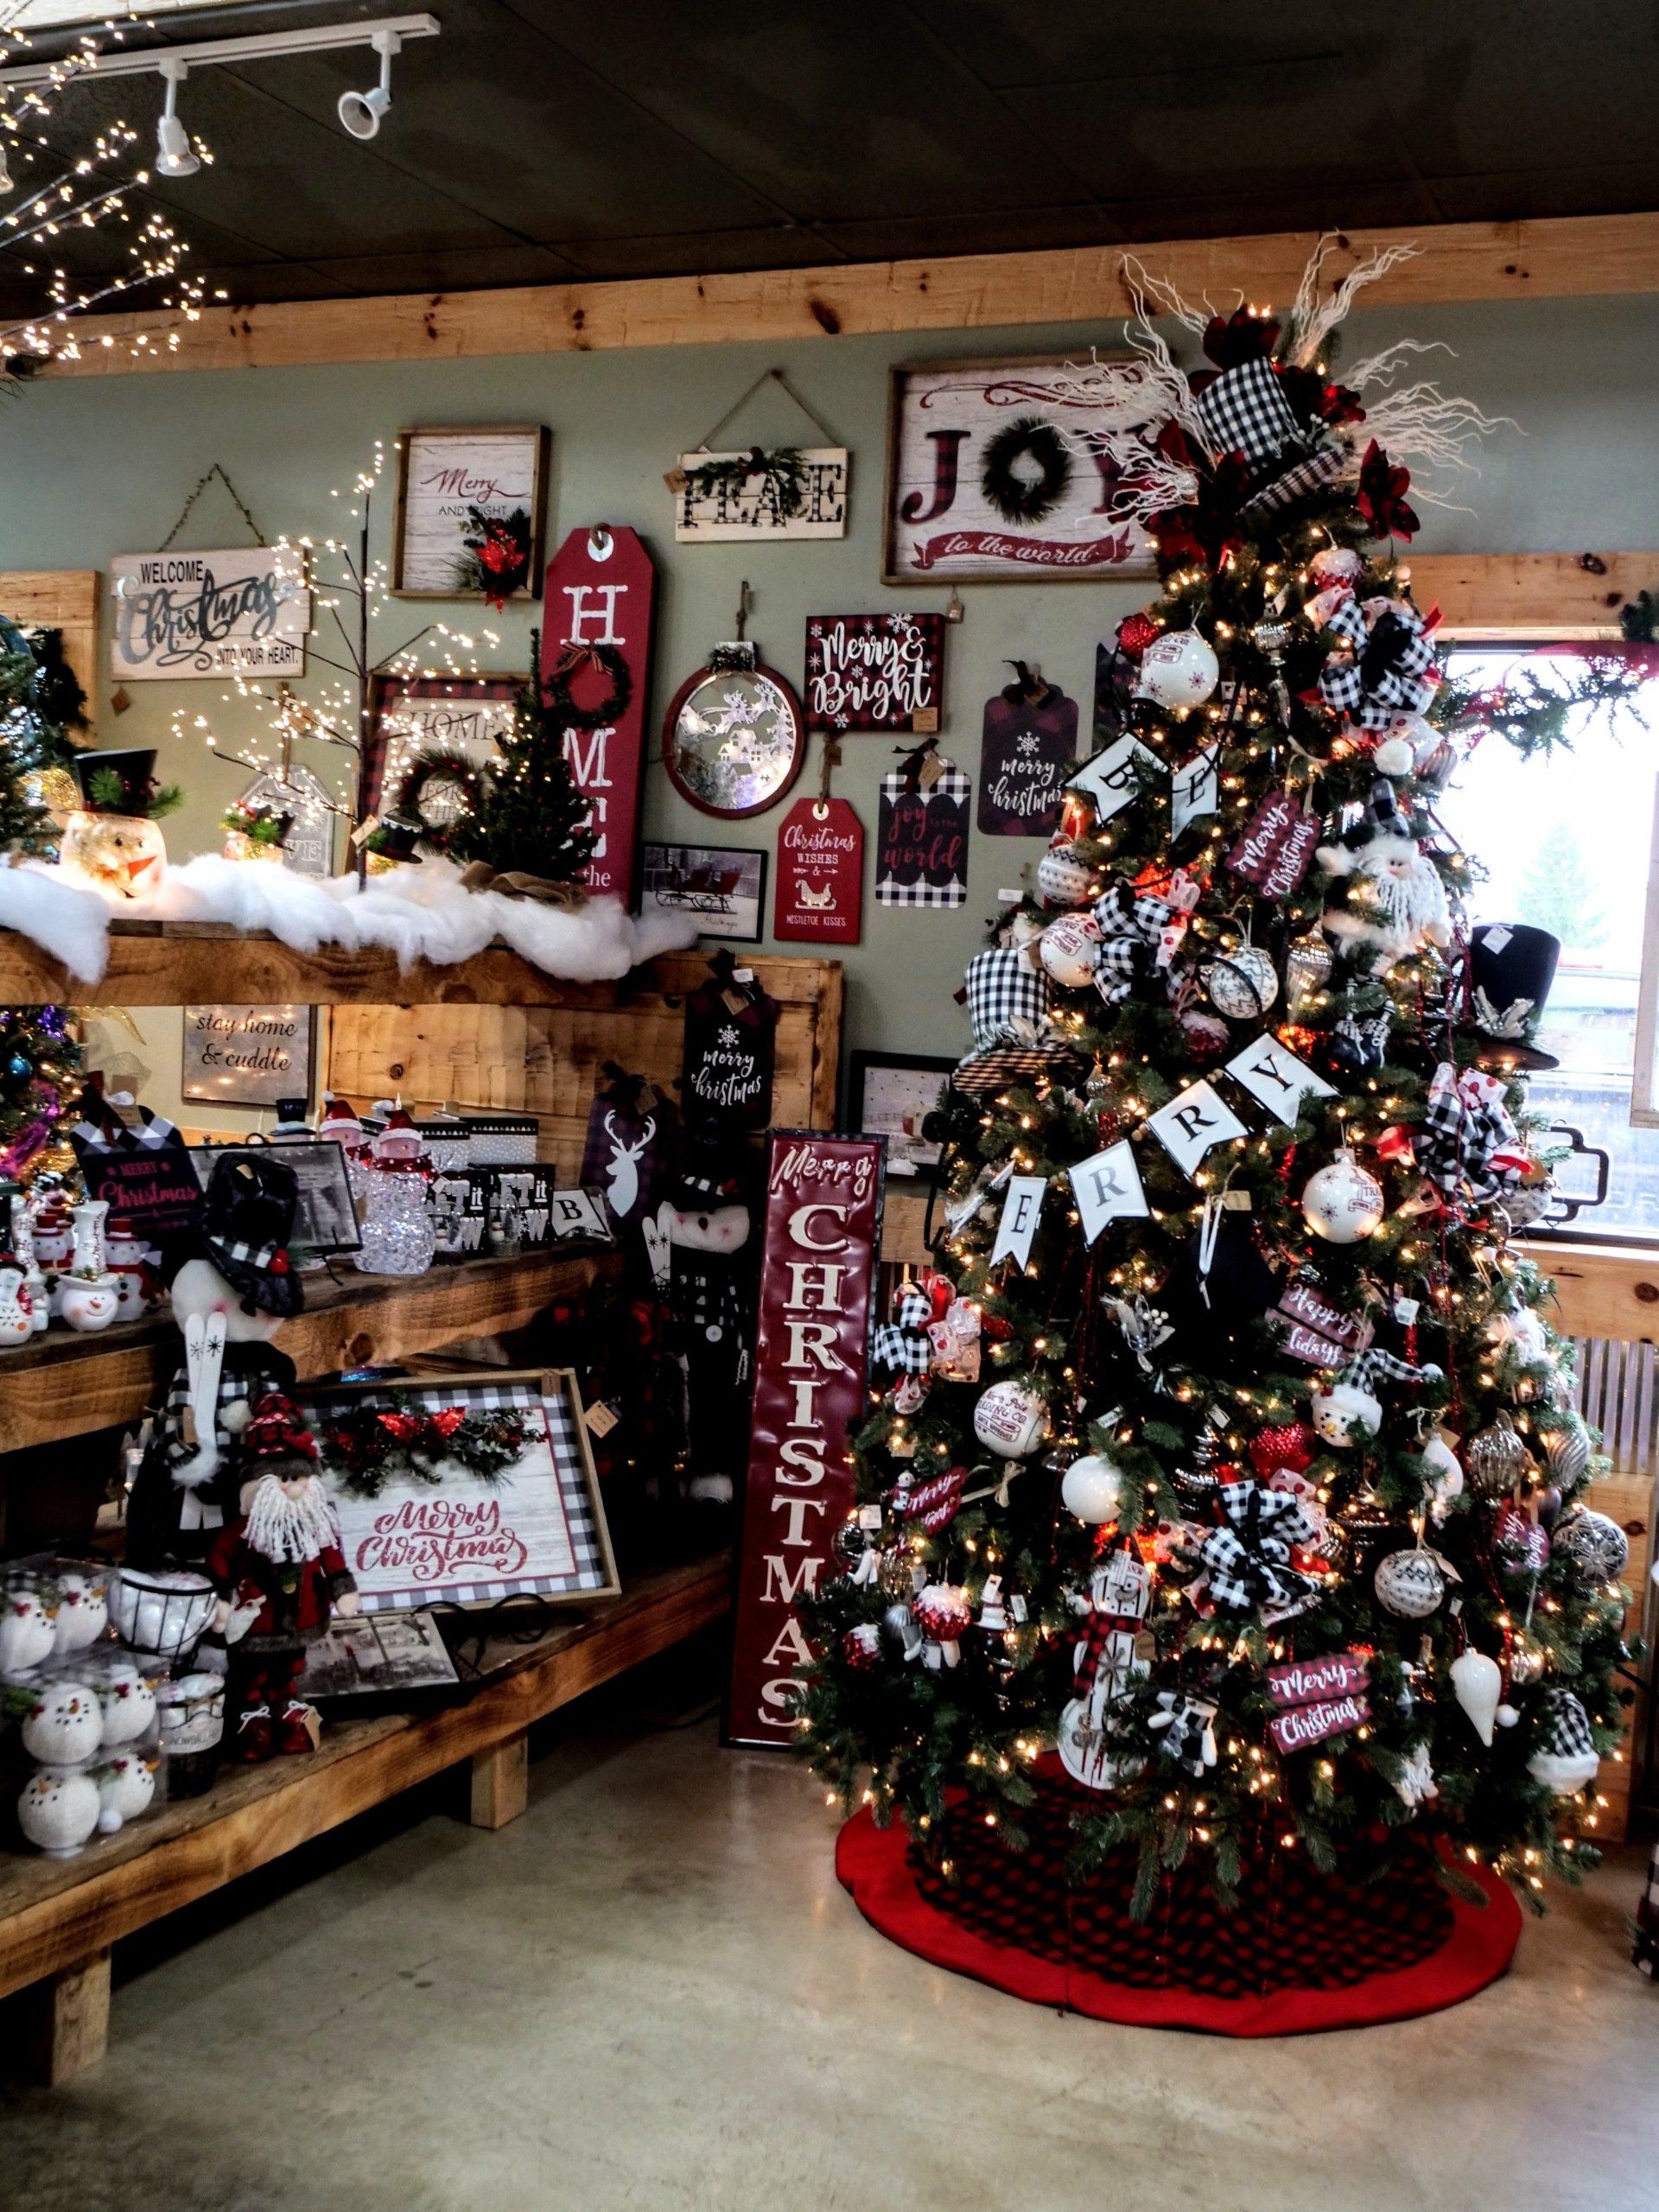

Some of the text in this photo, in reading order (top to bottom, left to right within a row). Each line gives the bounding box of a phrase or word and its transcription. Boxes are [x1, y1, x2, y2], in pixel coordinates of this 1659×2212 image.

[420, 468, 529, 503] Merry
[678, 464, 843, 528] PEAE
[438, 504, 508, 516] AND RIGHT
[944, 531, 1094, 563] to the world
[140, 560, 205, 584] WELCOME
[117, 569, 285, 671] Christmas
[241, 647, 263, 664] YOUR
[268, 646, 299, 664] HEART.
[818, 620, 927, 677] Merry &
[809, 663, 932, 720] Bright
[1001, 758, 1056, 787] merry
[784, 824, 856, 852] Christmas
[888, 805, 927, 843] joy
[1232, 802, 1289, 872] Merry
[797, 852, 839, 865] WISHES
[884, 834, 963, 870] world
[1262, 818, 1314, 897] Christmas
[811, 866, 821, 876] &
[786, 914, 847, 927] MISTLETOE KISSES
[196, 1008, 299, 1041] stay home
[201, 1042, 293, 1071] & cuddle
[702, 1050, 755, 1078] merry
[690, 1065, 762, 1106] christmas
[770, 1144, 873, 1198] Merry
[99, 1180, 199, 1210] Christmas
[555, 1198, 582, 1221] B
[1288, 1282, 1354, 1336] Happy
[1288, 1326, 1347, 1366] lidays
[758, 1204, 849, 1728] CHRISTMAS
[373, 1500, 500, 1540] Merry
[356, 1527, 528, 1581] Christmas
[1268, 1663, 1357, 1700] Merry
[1270, 1696, 1360, 1745] Christmas
